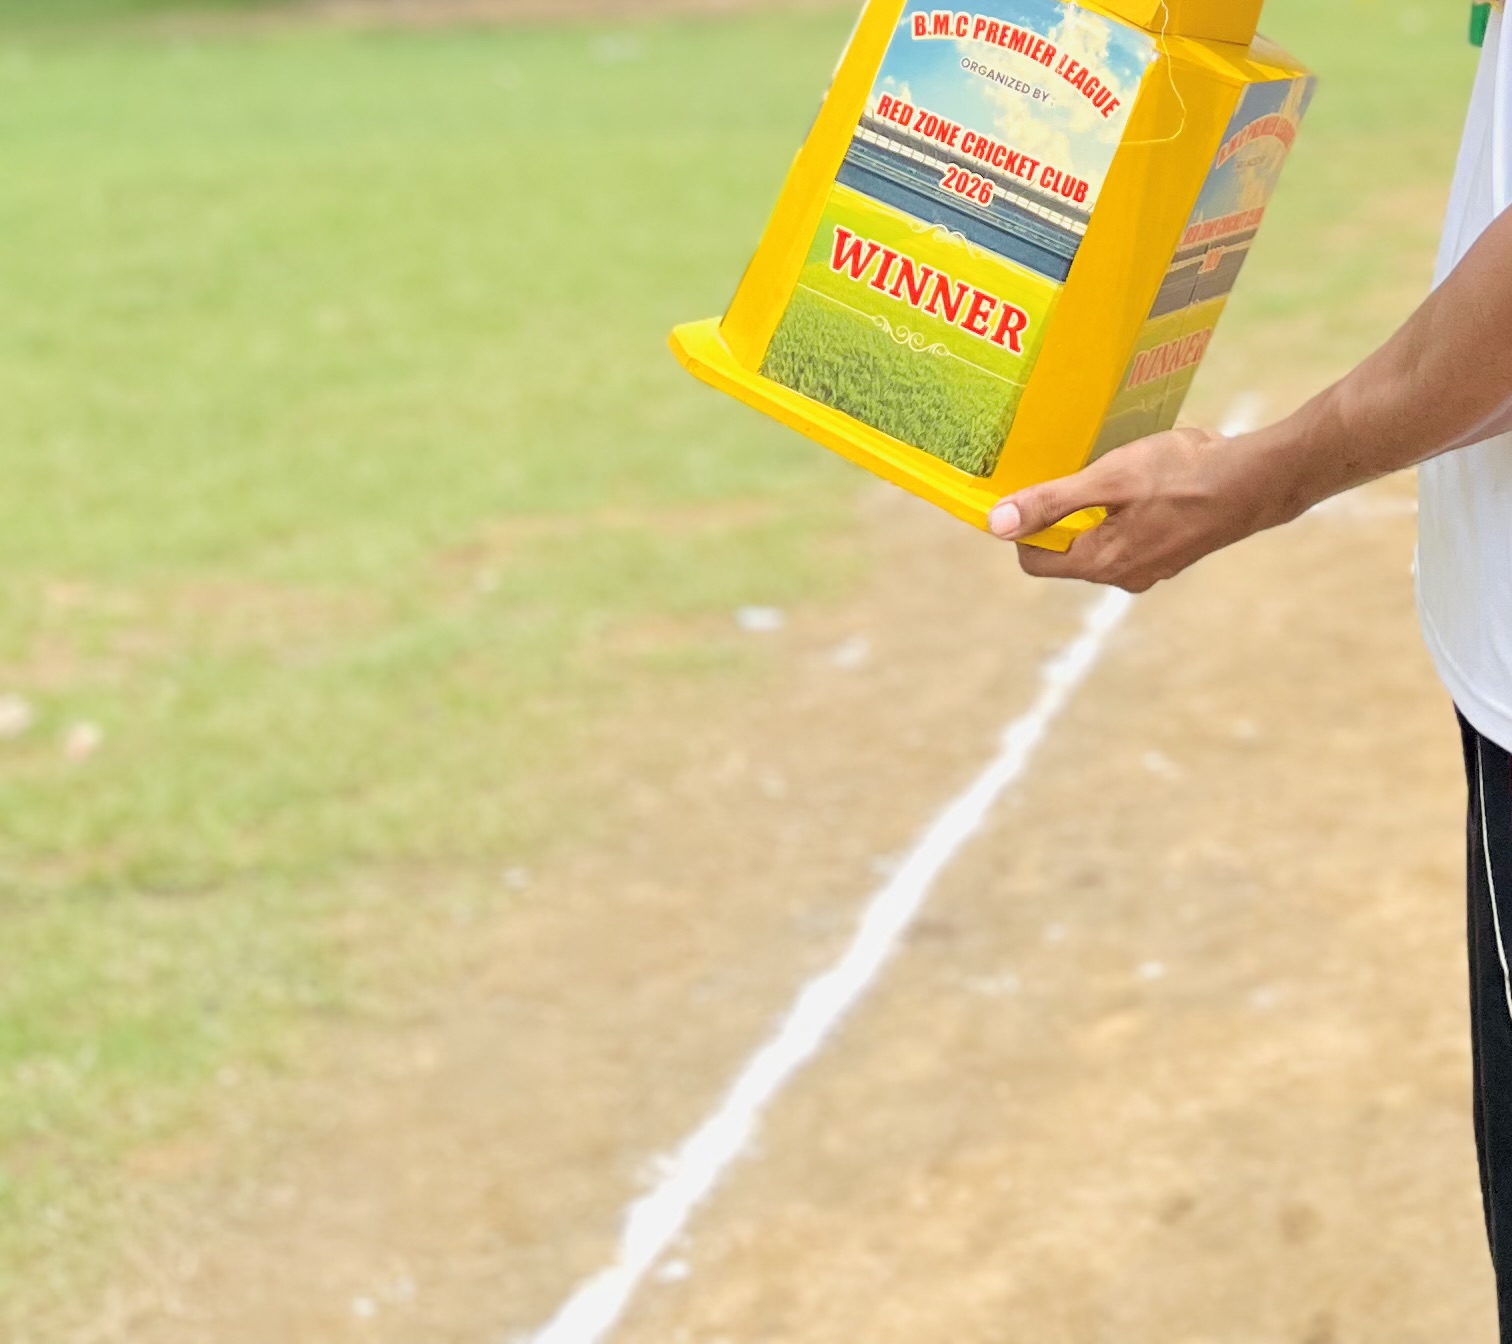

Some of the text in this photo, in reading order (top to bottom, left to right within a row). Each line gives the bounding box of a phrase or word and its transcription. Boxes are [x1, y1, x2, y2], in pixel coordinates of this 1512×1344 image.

[914, 13, 1120, 118] B.M.C PREMIER LEAGUE
[961, 58, 1031, 94] ORGANIZED
[876, 95, 1089, 203] RED ZONE CRICKET CLUB
[942, 166, 993, 204] 2026
[832, 228, 1027, 353] WINNER
